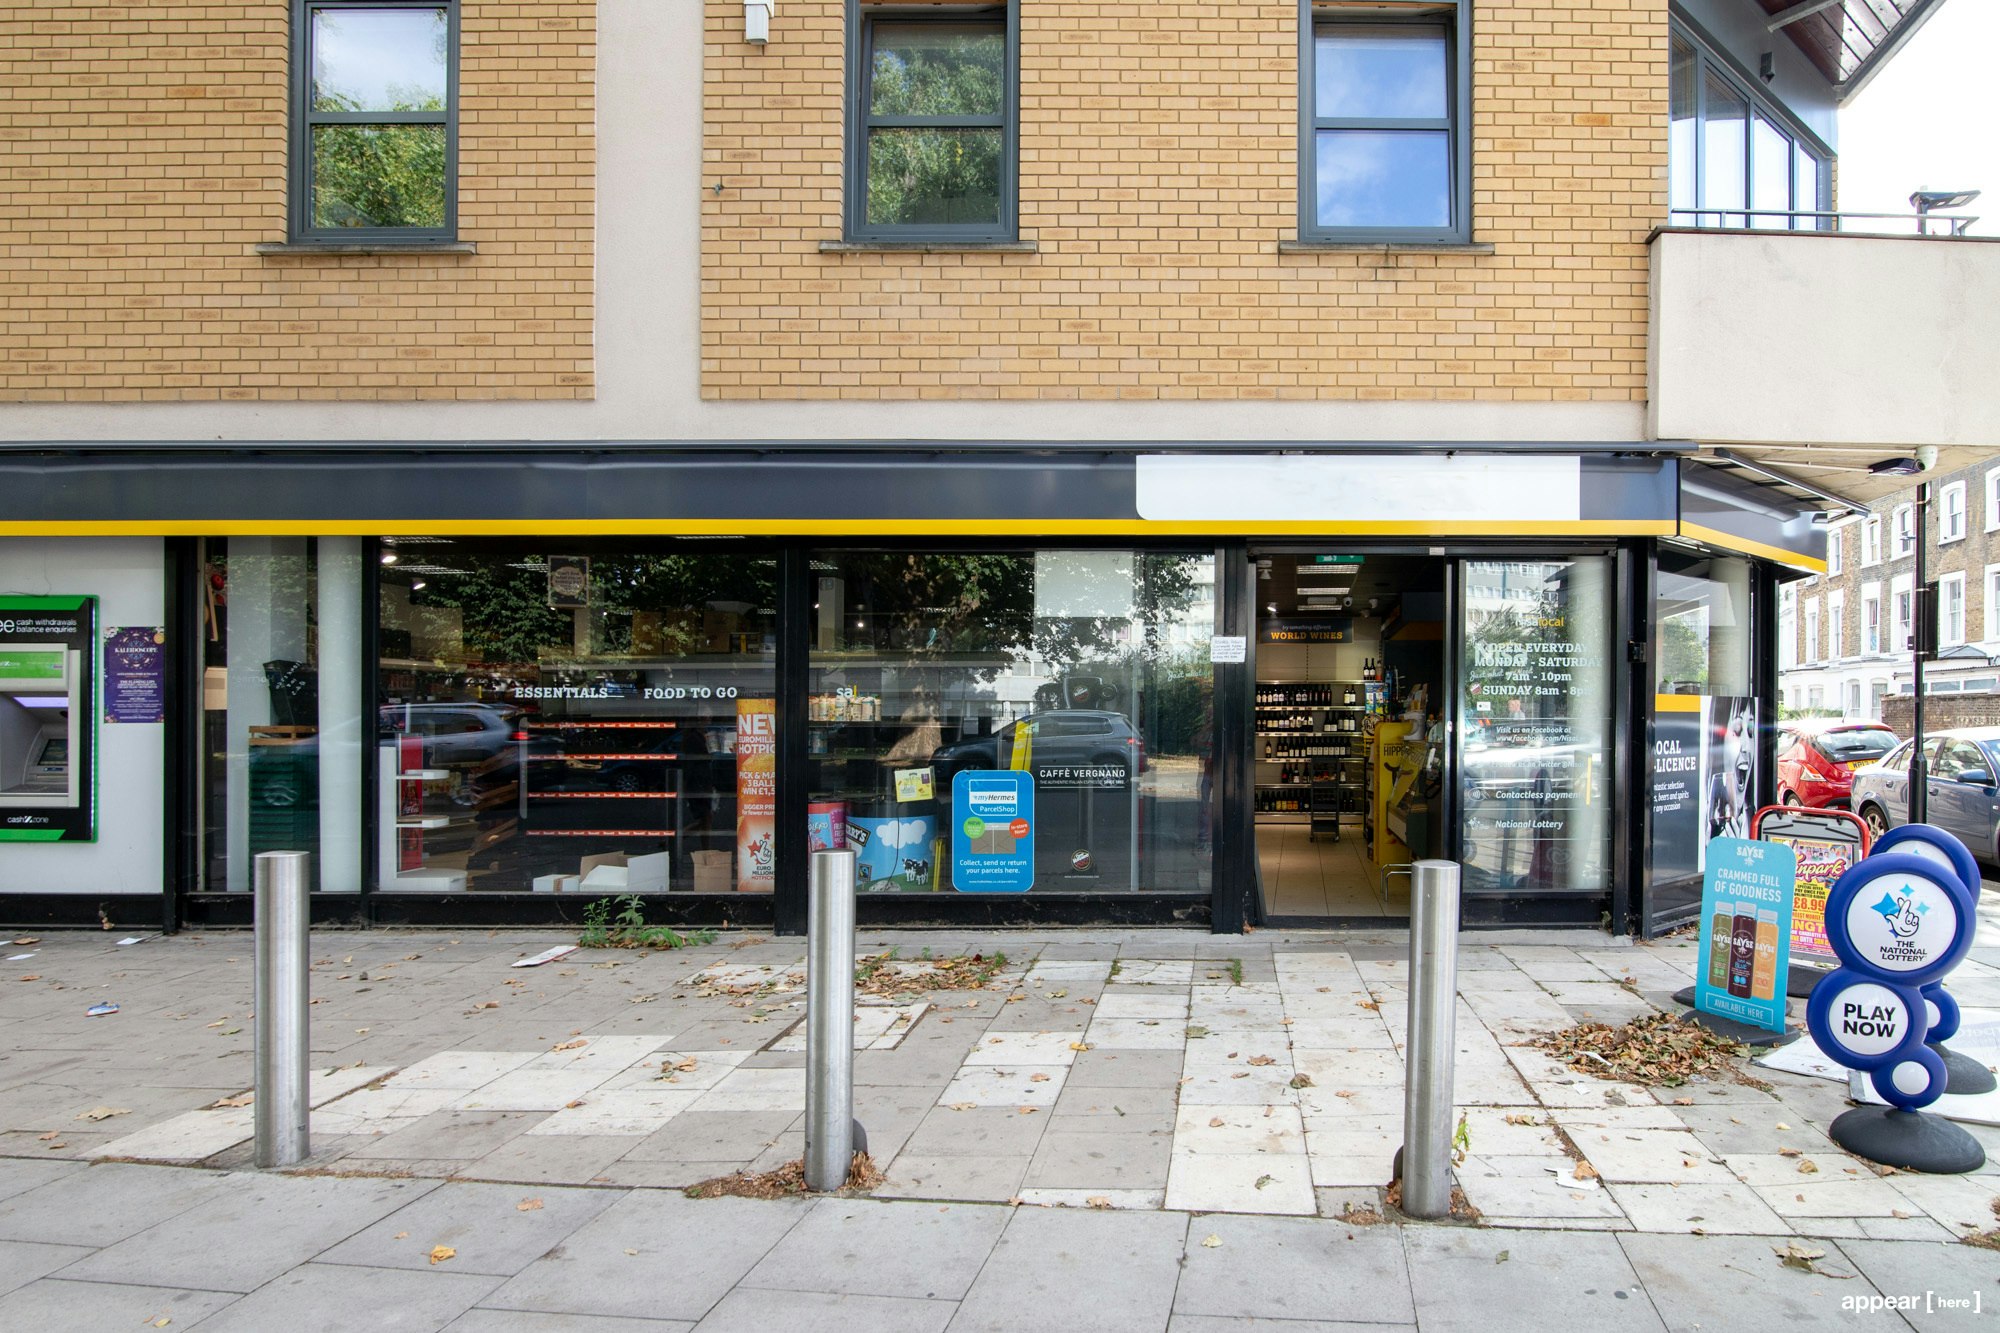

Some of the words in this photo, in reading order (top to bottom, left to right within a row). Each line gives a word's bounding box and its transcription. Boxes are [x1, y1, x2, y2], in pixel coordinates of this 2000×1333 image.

[1492, 643, 1524, 653] OPEN
[1474, 657, 1527, 667] MONDAY
[1538, 657, 1602, 667] SATURDAY
[1505, 672, 1530, 681] 7am
[1541, 672, 1572, 682] 10pm
[514, 686, 608, 698] ESSENTIALS
[644, 688, 686, 699] FOOD
[690, 687, 711, 698] TO
[716, 687, 738, 698] GO
[1482, 686, 1532, 695] SUNDAY
[1534, 686, 1559, 695] 8am
[1040, 768, 1070, 778] CAFFÈ
[1074, 769, 1126, 778] VERGNANO
[1668, 781, 1684, 790] selection
[1496, 790, 1543, 799] Contactless
[1658, 792, 1669, 801] beers
[1678, 790, 1690, 801] spirits
[1664, 802, 1681, 811] occasion
[1496, 820, 1531, 828] National
[1532, 820, 1564, 830] Lottery
[1718, 868, 1758, 884] CRAMMED
[1760, 874, 1781, 888] FULL
[1714, 880, 1727, 893] OF
[1729, 883, 1782, 903] GOODNESS
[1794, 897, 1825, 911] £8.99
[1880, 946, 1928, 955] NATIONAL
[1714, 998, 1745, 1015] AVAILABLE
[1747, 1006, 1764, 1019] HERE
[1844, 1003, 1896, 1021] PLAY
[1843, 1020, 1896, 1038] NOW
